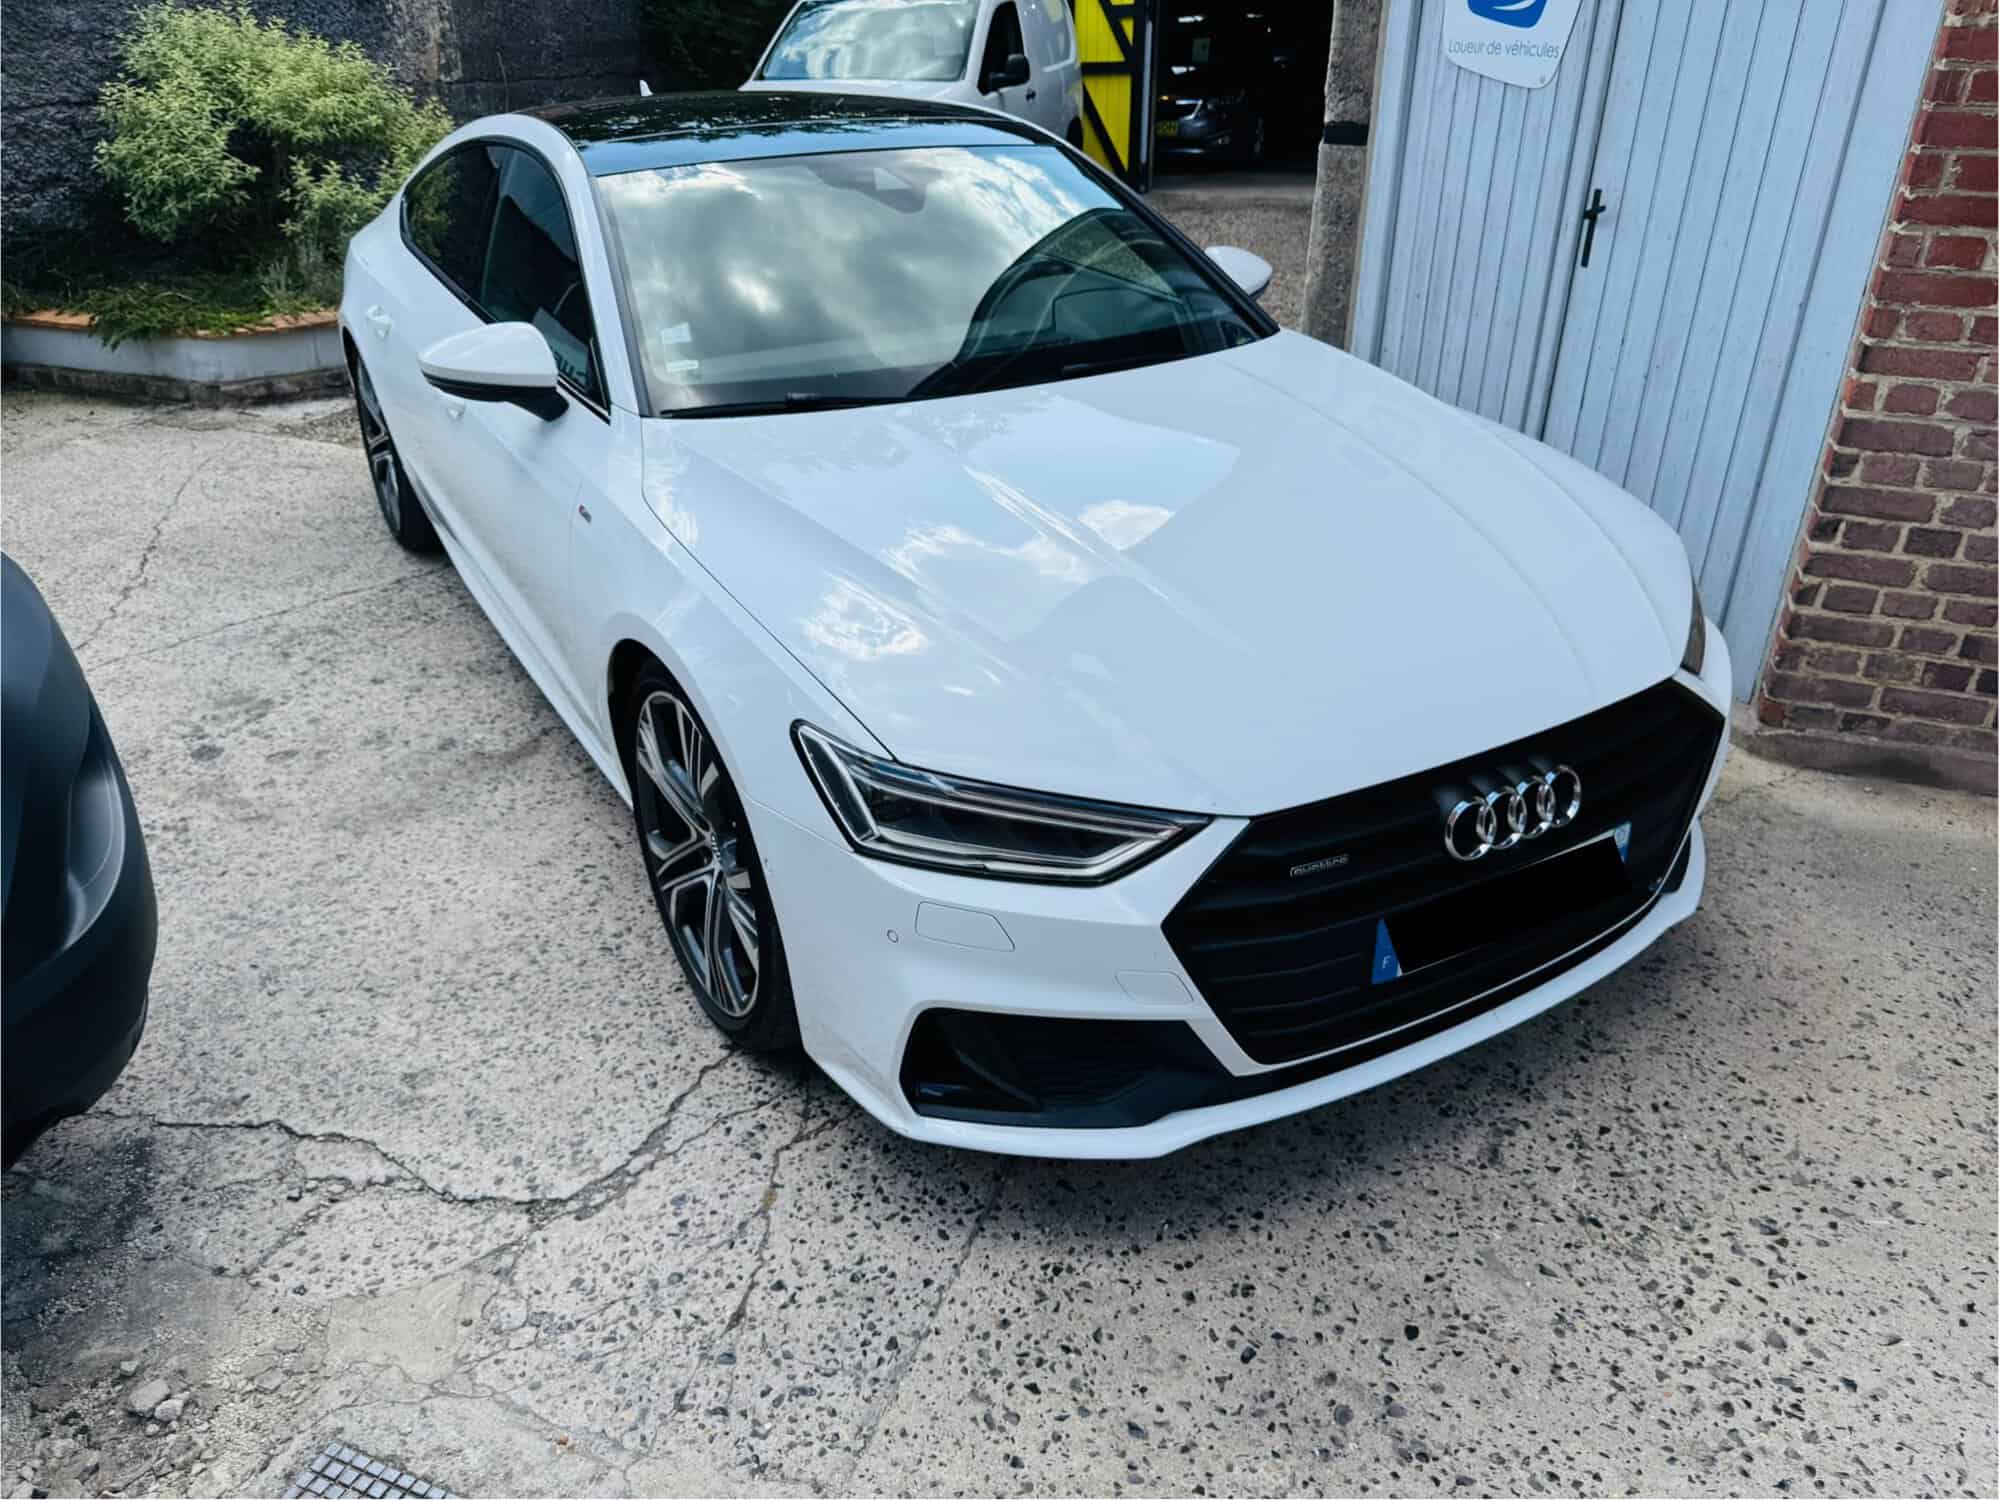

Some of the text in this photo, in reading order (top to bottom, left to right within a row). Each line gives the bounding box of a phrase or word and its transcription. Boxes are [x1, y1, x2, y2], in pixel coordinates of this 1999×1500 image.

[1448, 39, 1560, 58] Loueur de véhicules
[1382, 954, 1392, 969] F
